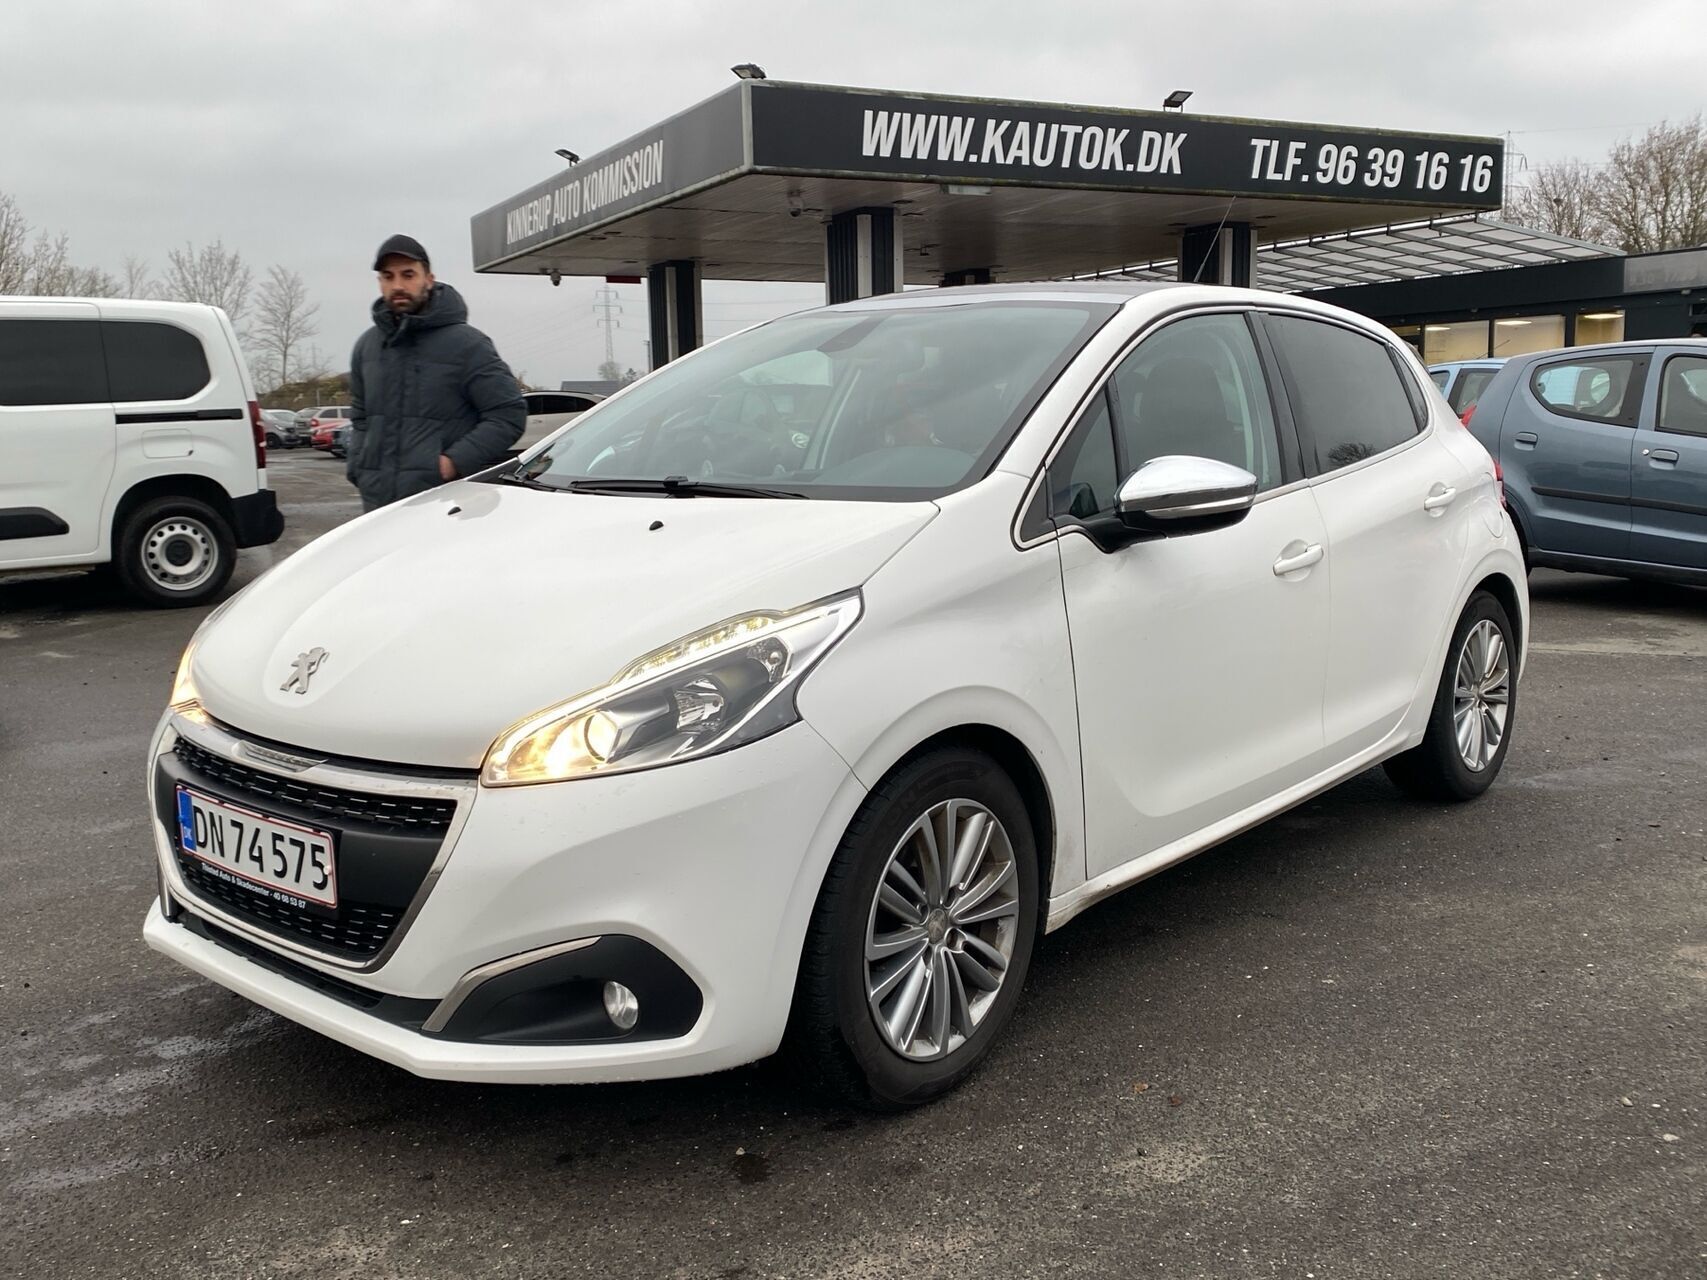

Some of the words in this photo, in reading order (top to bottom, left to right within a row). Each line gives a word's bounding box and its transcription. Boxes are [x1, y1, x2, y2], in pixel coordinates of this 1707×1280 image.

[506, 194, 552, 245] KINNERUP
[552, 180, 581, 226] AUTO
[582, 140, 664, 214] KOMMISSION
[862, 110, 1187, 175] WWW.KAUTOK.DK
[1250, 138, 1309, 182] TLF.
[1316, 143, 1359, 186] 96
[1363, 148, 1405, 188] 39
[1415, 151, 1449, 190] 16
[1460, 154, 1494, 193] 16
